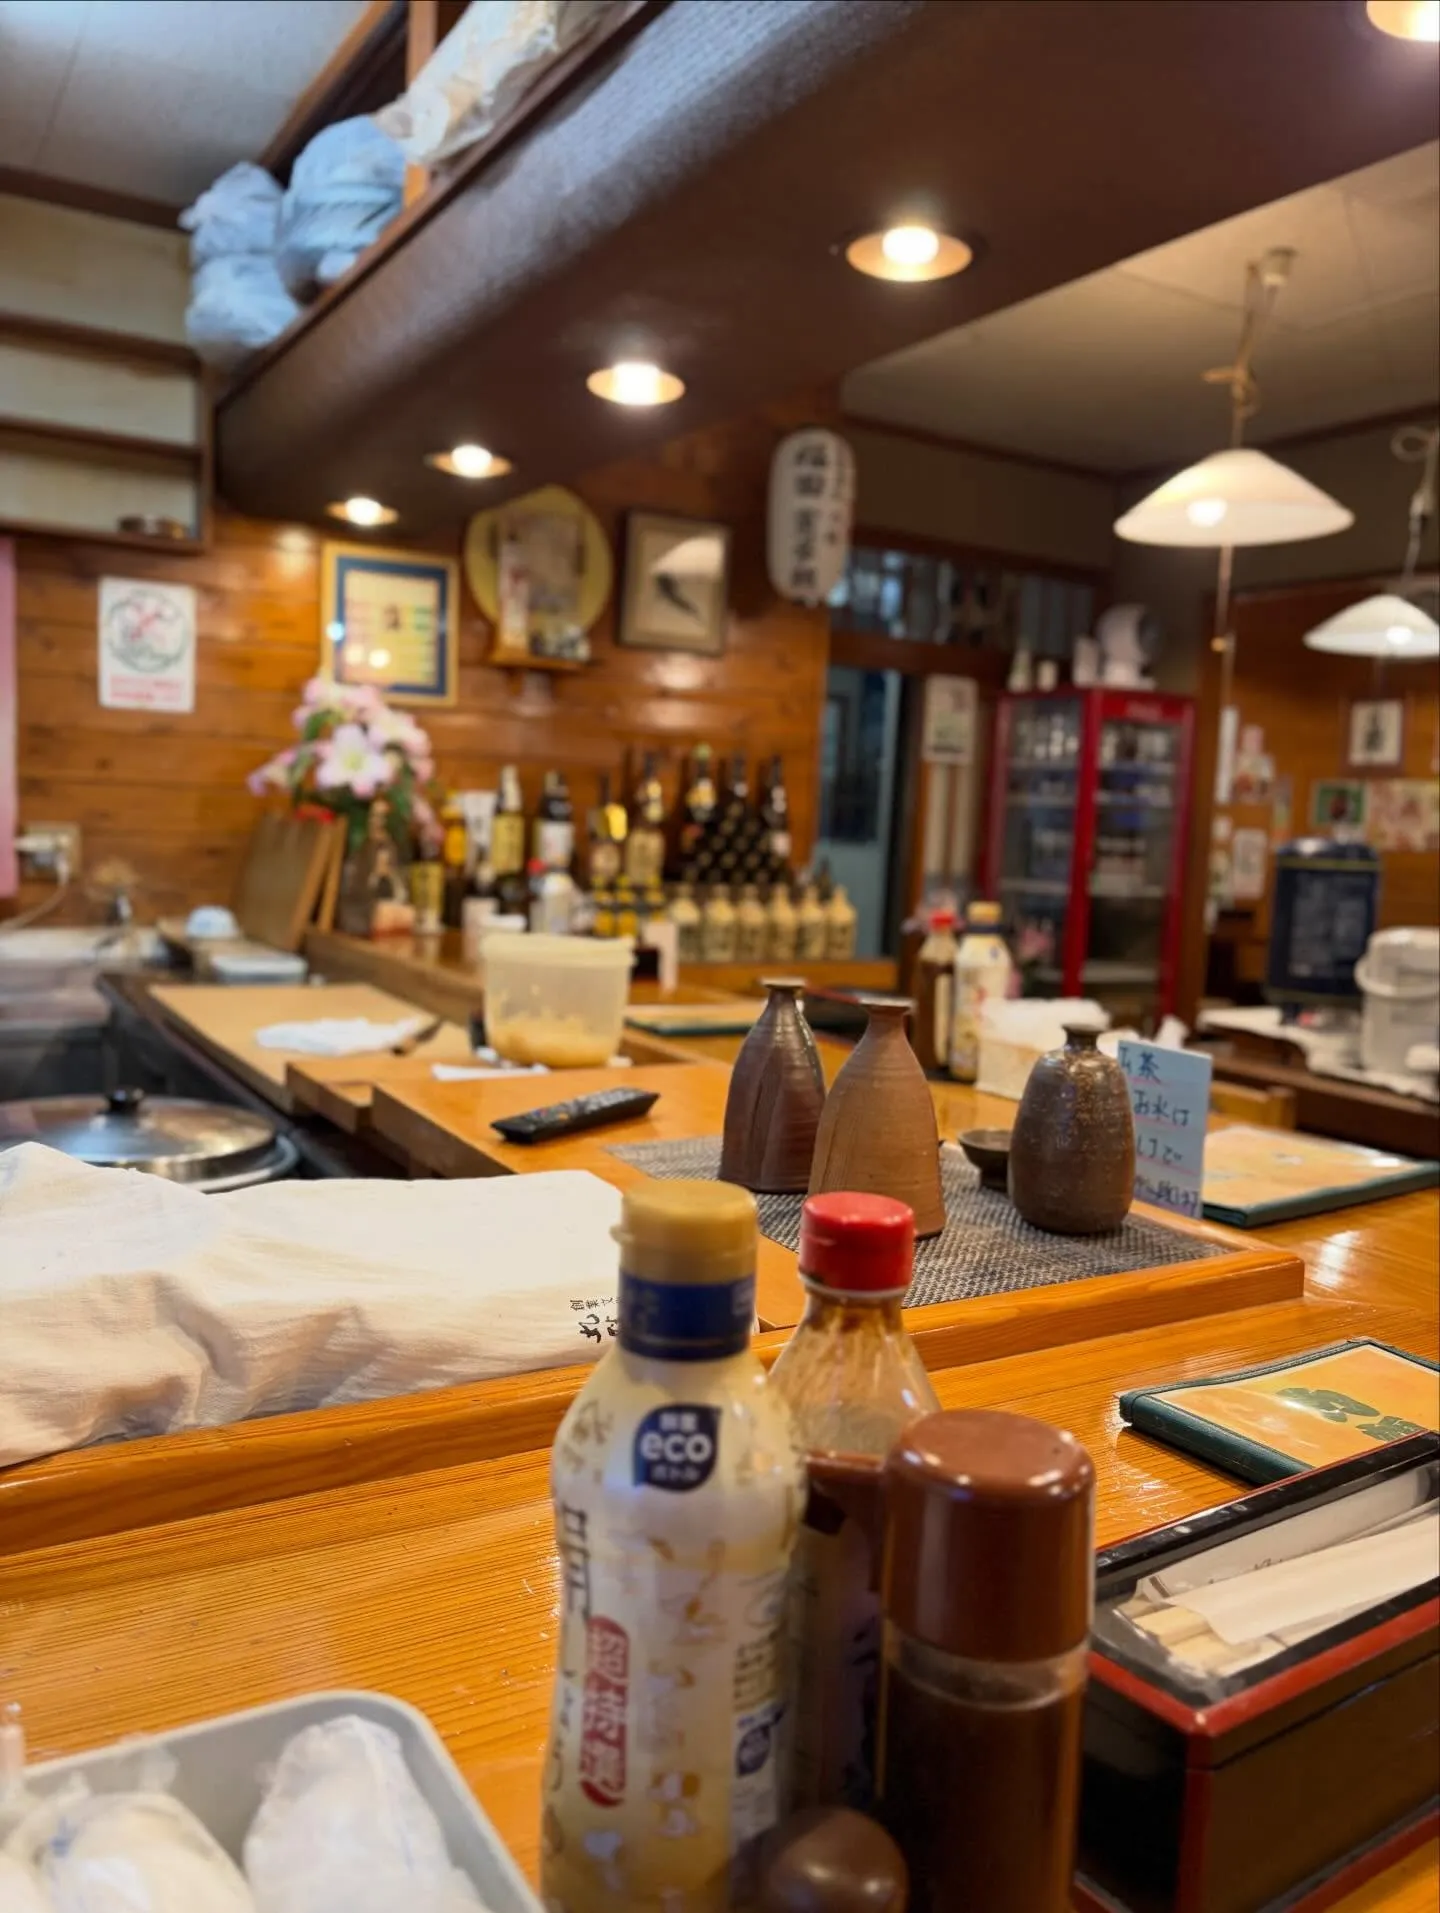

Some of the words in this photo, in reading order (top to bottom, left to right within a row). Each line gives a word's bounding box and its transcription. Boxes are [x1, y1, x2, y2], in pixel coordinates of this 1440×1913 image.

[1134, 1089, 1190, 1127] お水は
[640, 1431, 713, 1463] eco
